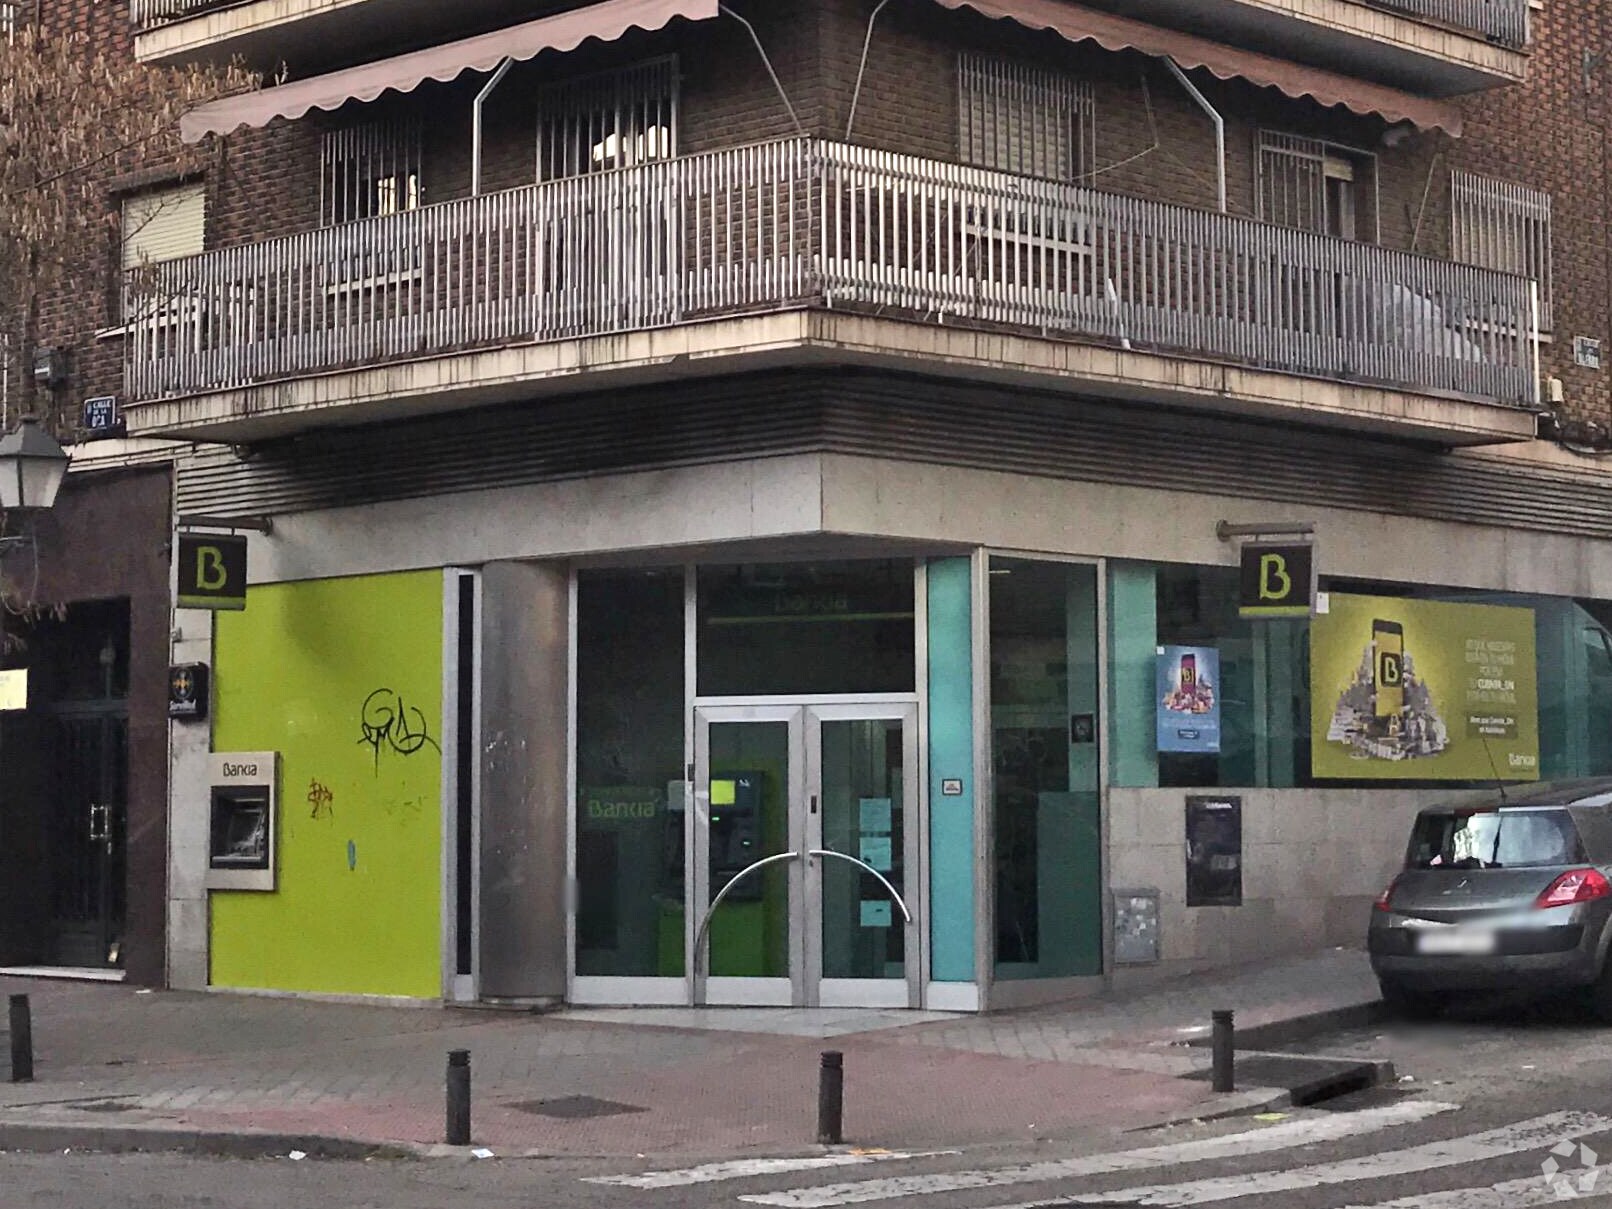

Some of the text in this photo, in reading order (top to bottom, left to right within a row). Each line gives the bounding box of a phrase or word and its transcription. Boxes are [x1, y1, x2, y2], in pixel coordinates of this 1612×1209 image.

[93, 400, 111, 409] CALLE
[92, 415, 105, 427] OCA
[197, 546, 227, 590] B
[1260, 553, 1291, 599] B
[1385, 657, 1398, 682] B
[223, 762, 257, 777] Bankia
[588, 800, 656, 818] Bankia
